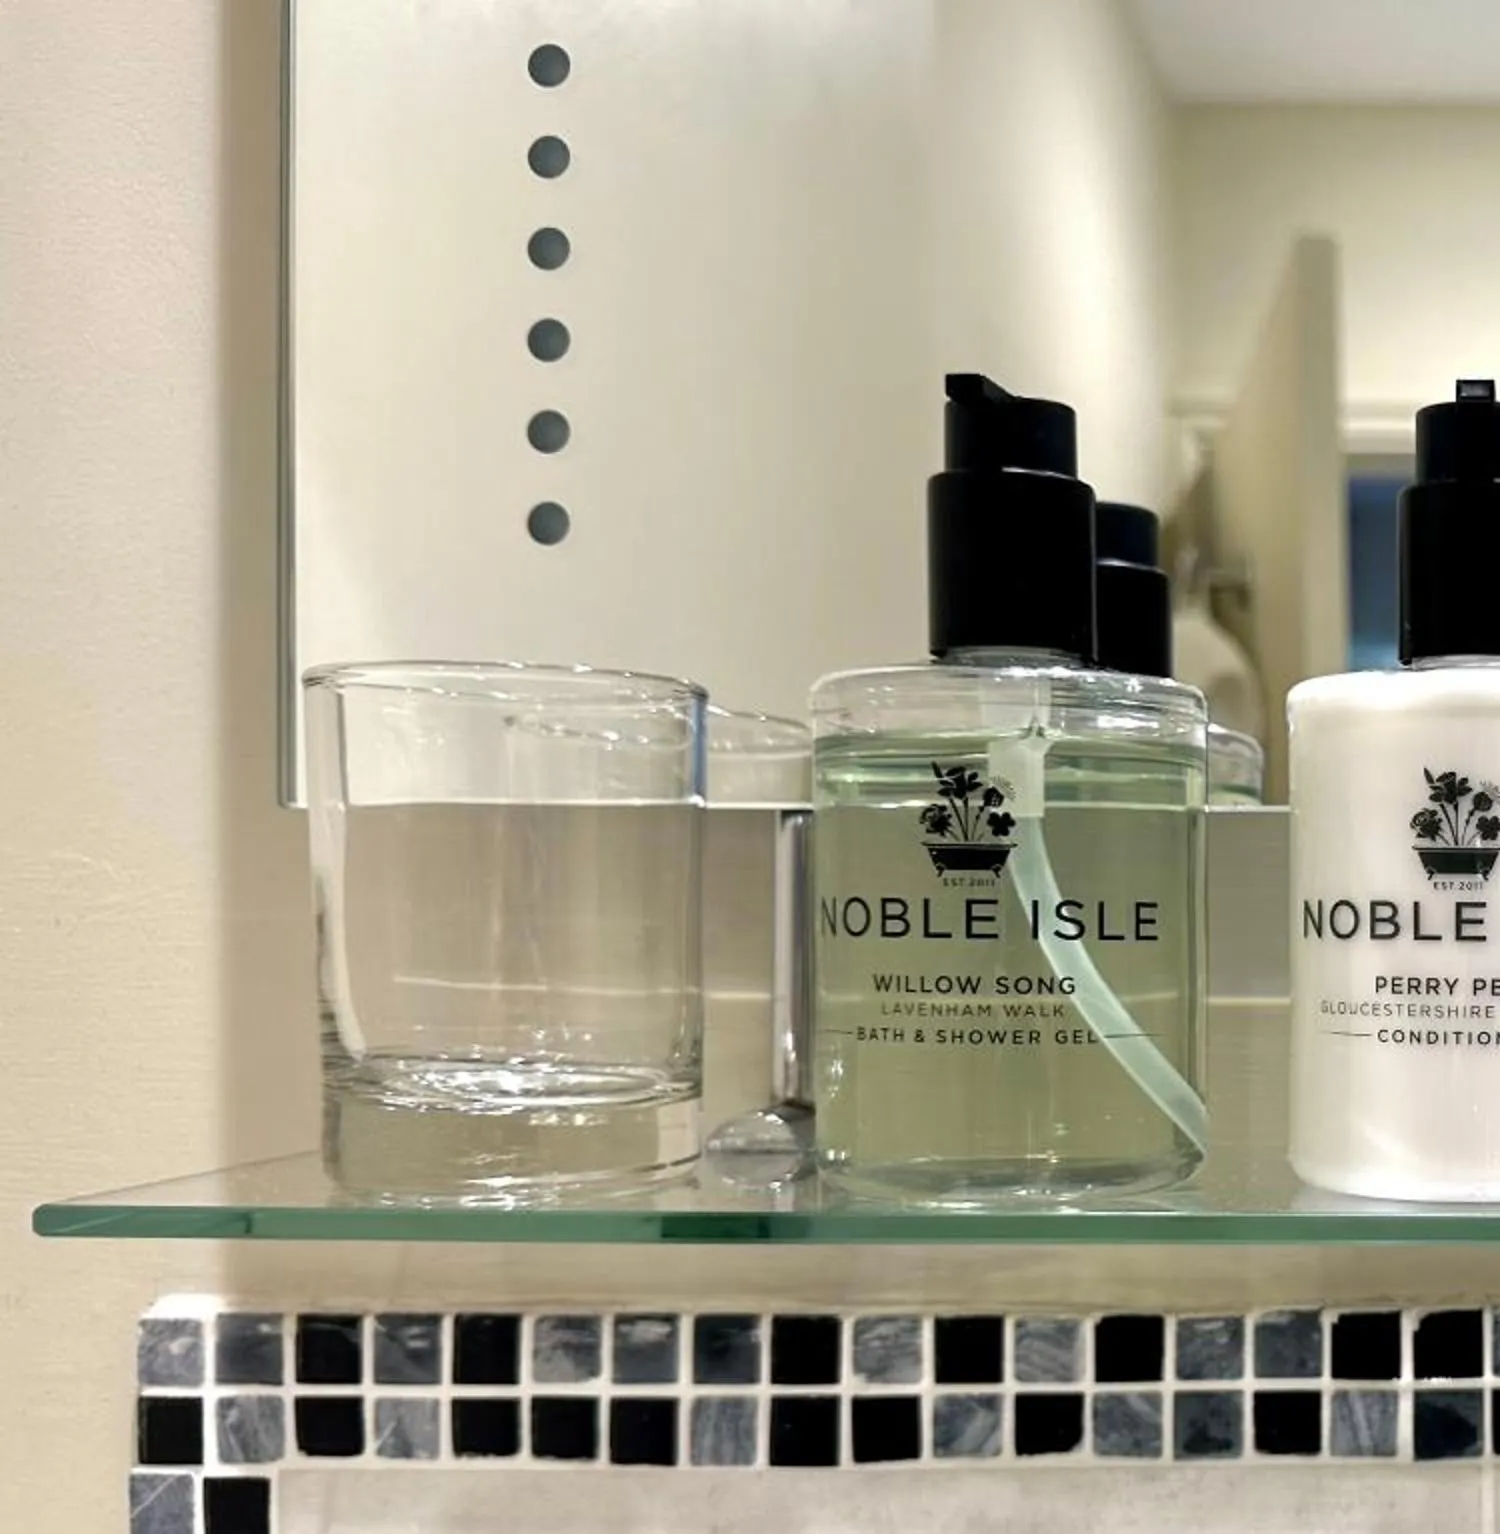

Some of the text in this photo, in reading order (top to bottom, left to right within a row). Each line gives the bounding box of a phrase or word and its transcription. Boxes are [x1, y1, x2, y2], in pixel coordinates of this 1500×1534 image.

[821, 896, 1160, 941] NOBLE ISLE
[1303, 899, 1488, 943] NOBLE
[873, 973, 1077, 996] WILLOW SONG
[1375, 975, 1460, 996] PERRY
[880, 1002, 1065, 1019] LAVENHAM WALK
[1321, 1000, 1495, 1019] GLOUCESTERSHIRE
[856, 1027, 1098, 1045] BATH & SHOWER GEL
